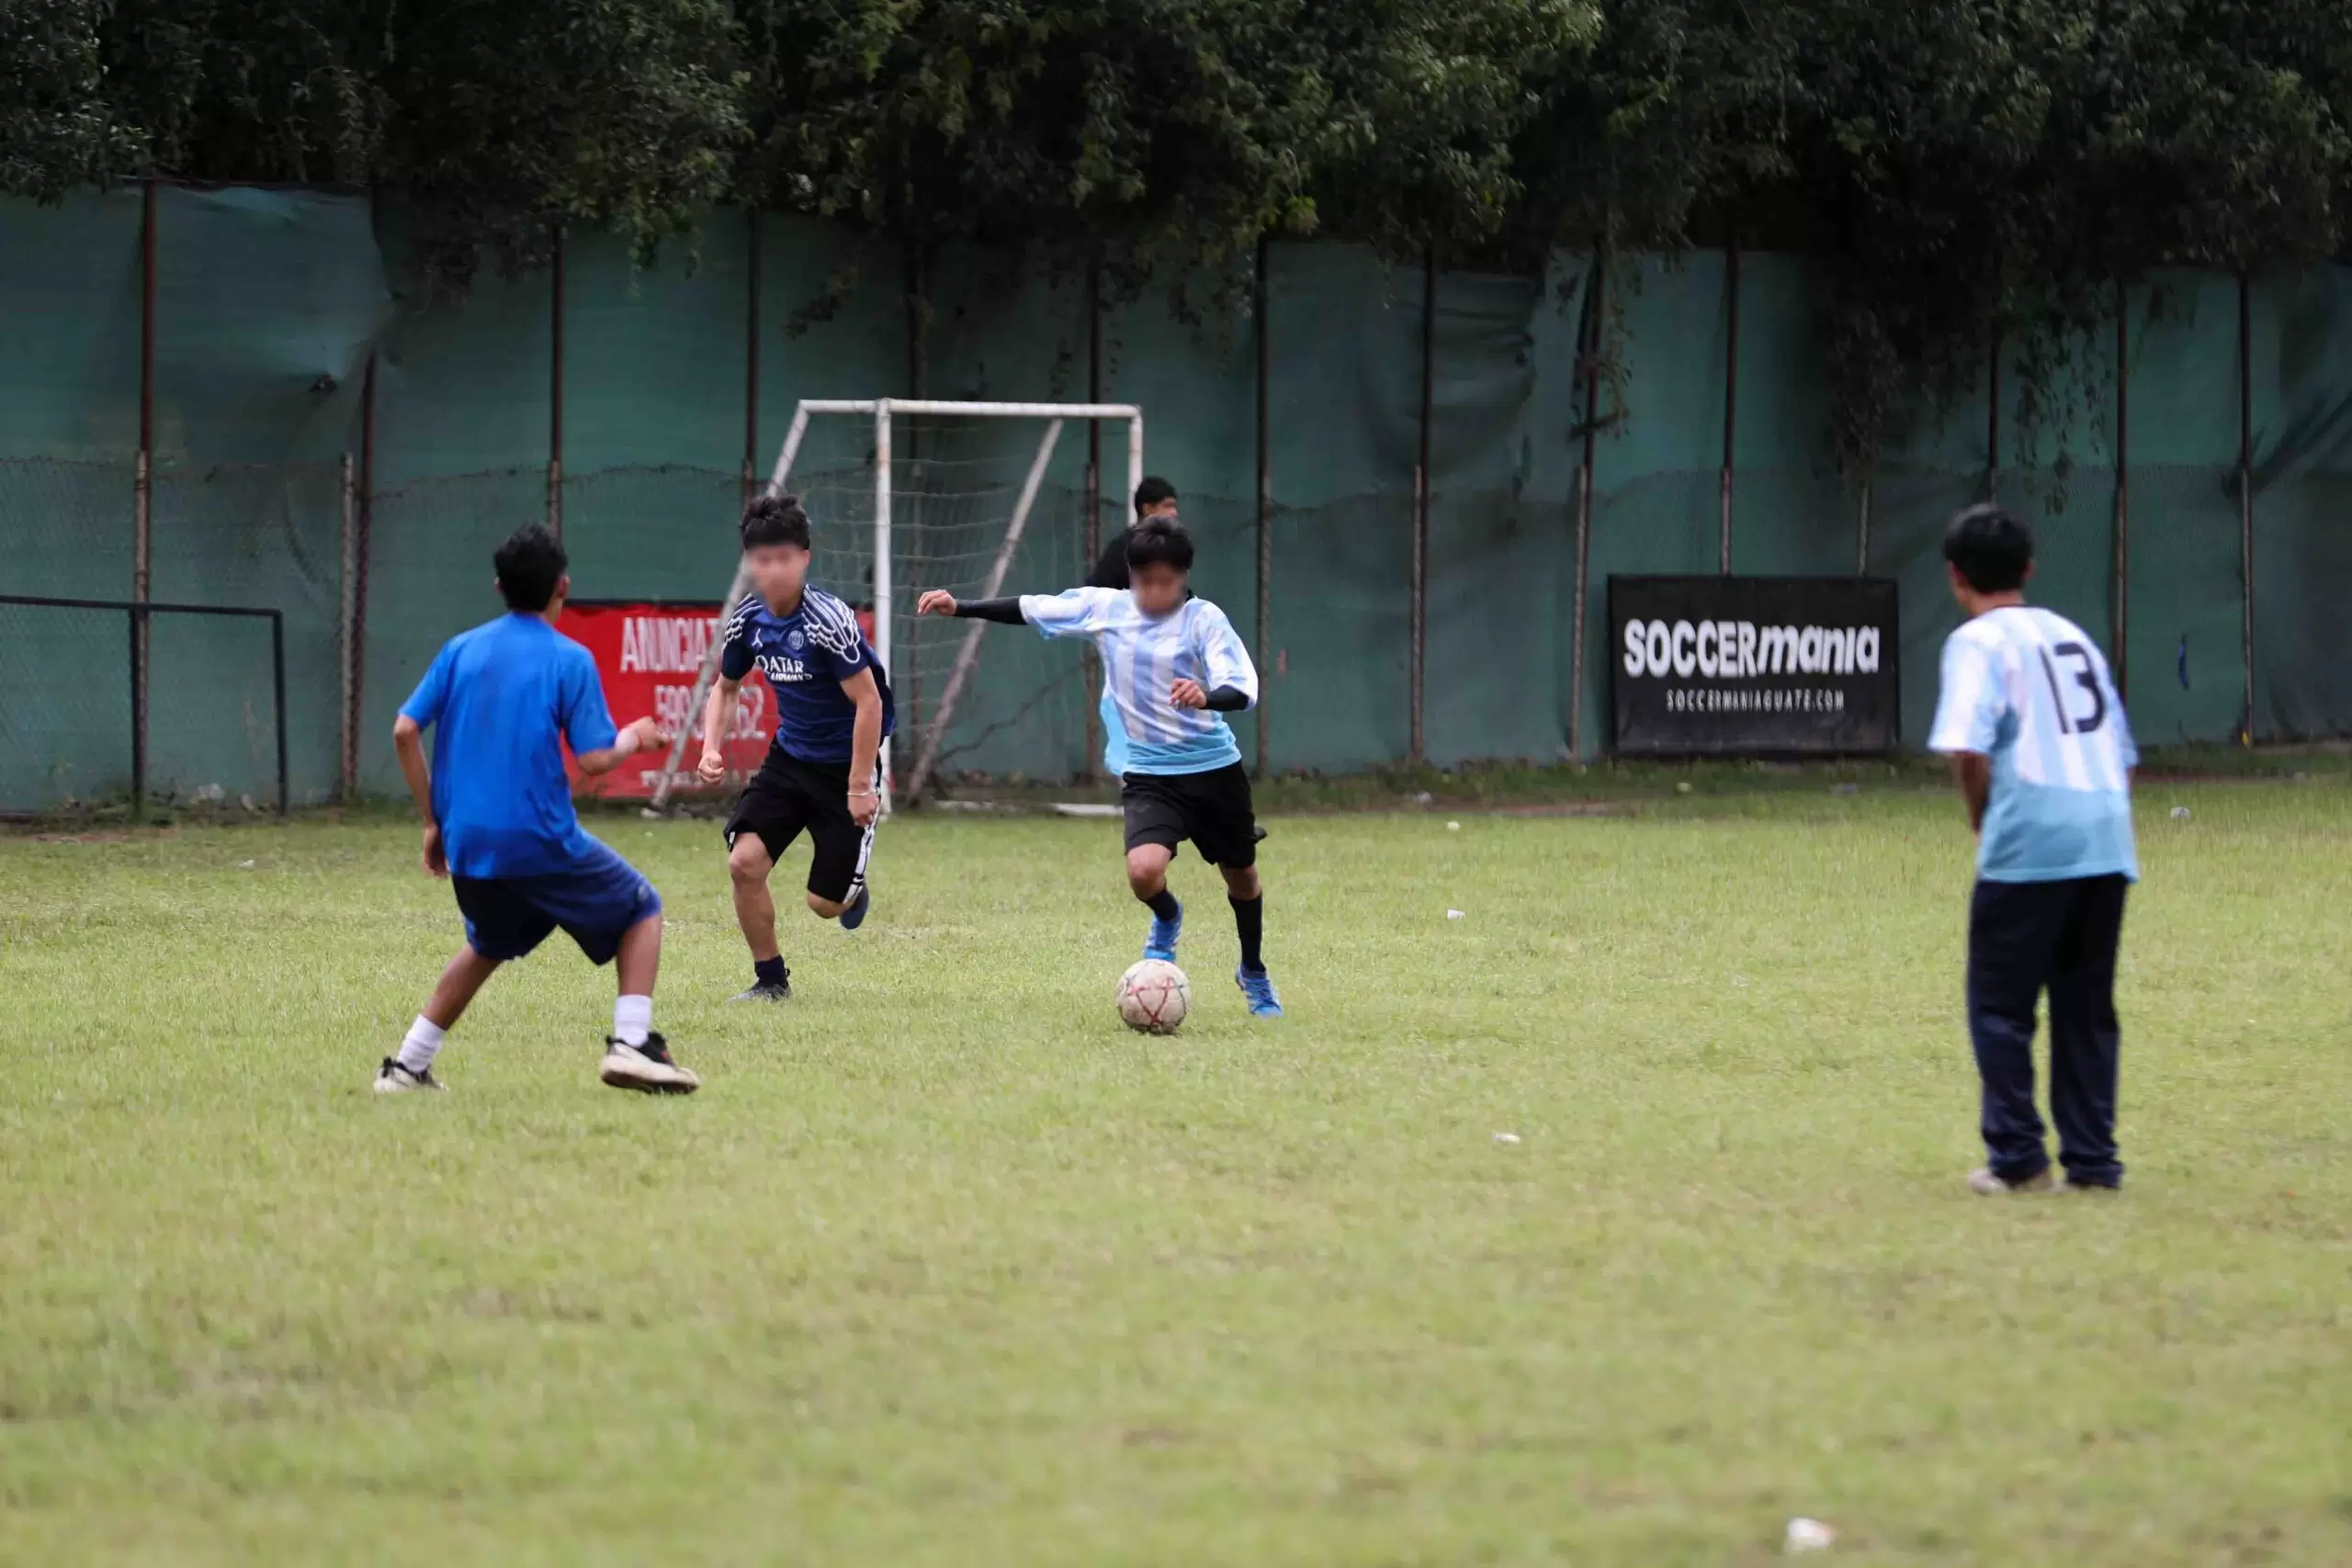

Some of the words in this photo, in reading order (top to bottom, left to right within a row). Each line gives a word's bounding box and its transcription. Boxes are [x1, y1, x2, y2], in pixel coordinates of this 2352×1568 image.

[754, 655, 805, 674] QATAR
[1623, 618, 1880, 678] SOCCERmania
[1666, 689, 1845, 713] SOCCERMANIAGUATE.COM
[2038, 641, 2105, 735] 13
